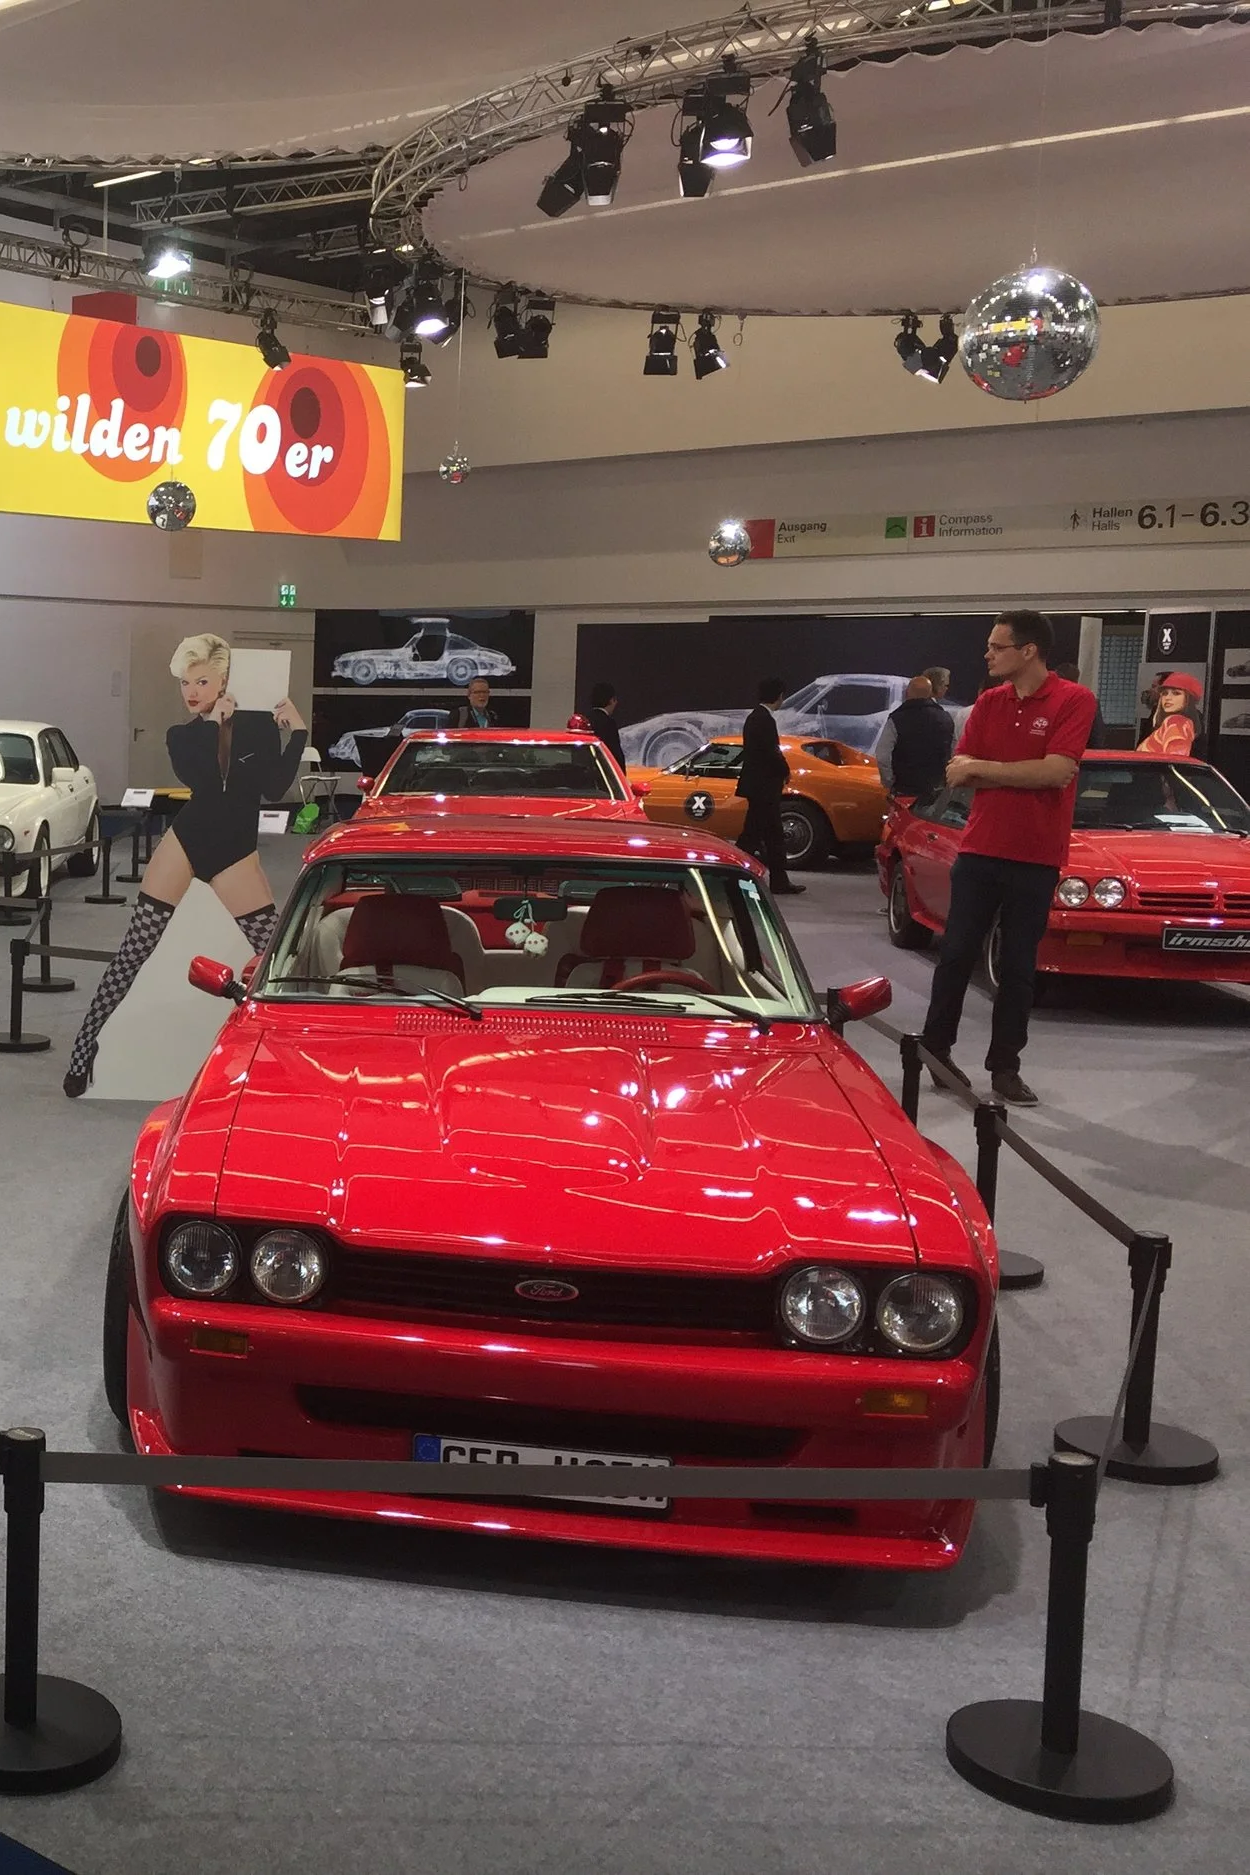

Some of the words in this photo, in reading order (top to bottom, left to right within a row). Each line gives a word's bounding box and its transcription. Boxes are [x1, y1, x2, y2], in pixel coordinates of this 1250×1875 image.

[4, 393, 184, 465] wilden
[206, 398, 334, 479] 70er
[1093, 506, 1133, 519] Hallen
[939, 514, 993, 527] Compass
[1091, 520, 1121, 532] Halls
[778, 522, 827, 534] Ausgang
[939, 525, 1004, 537] Information
[777, 534, 796, 544] Exit
[691, 796, 707, 810] X
[530, 1284, 564, 1297] Ford
